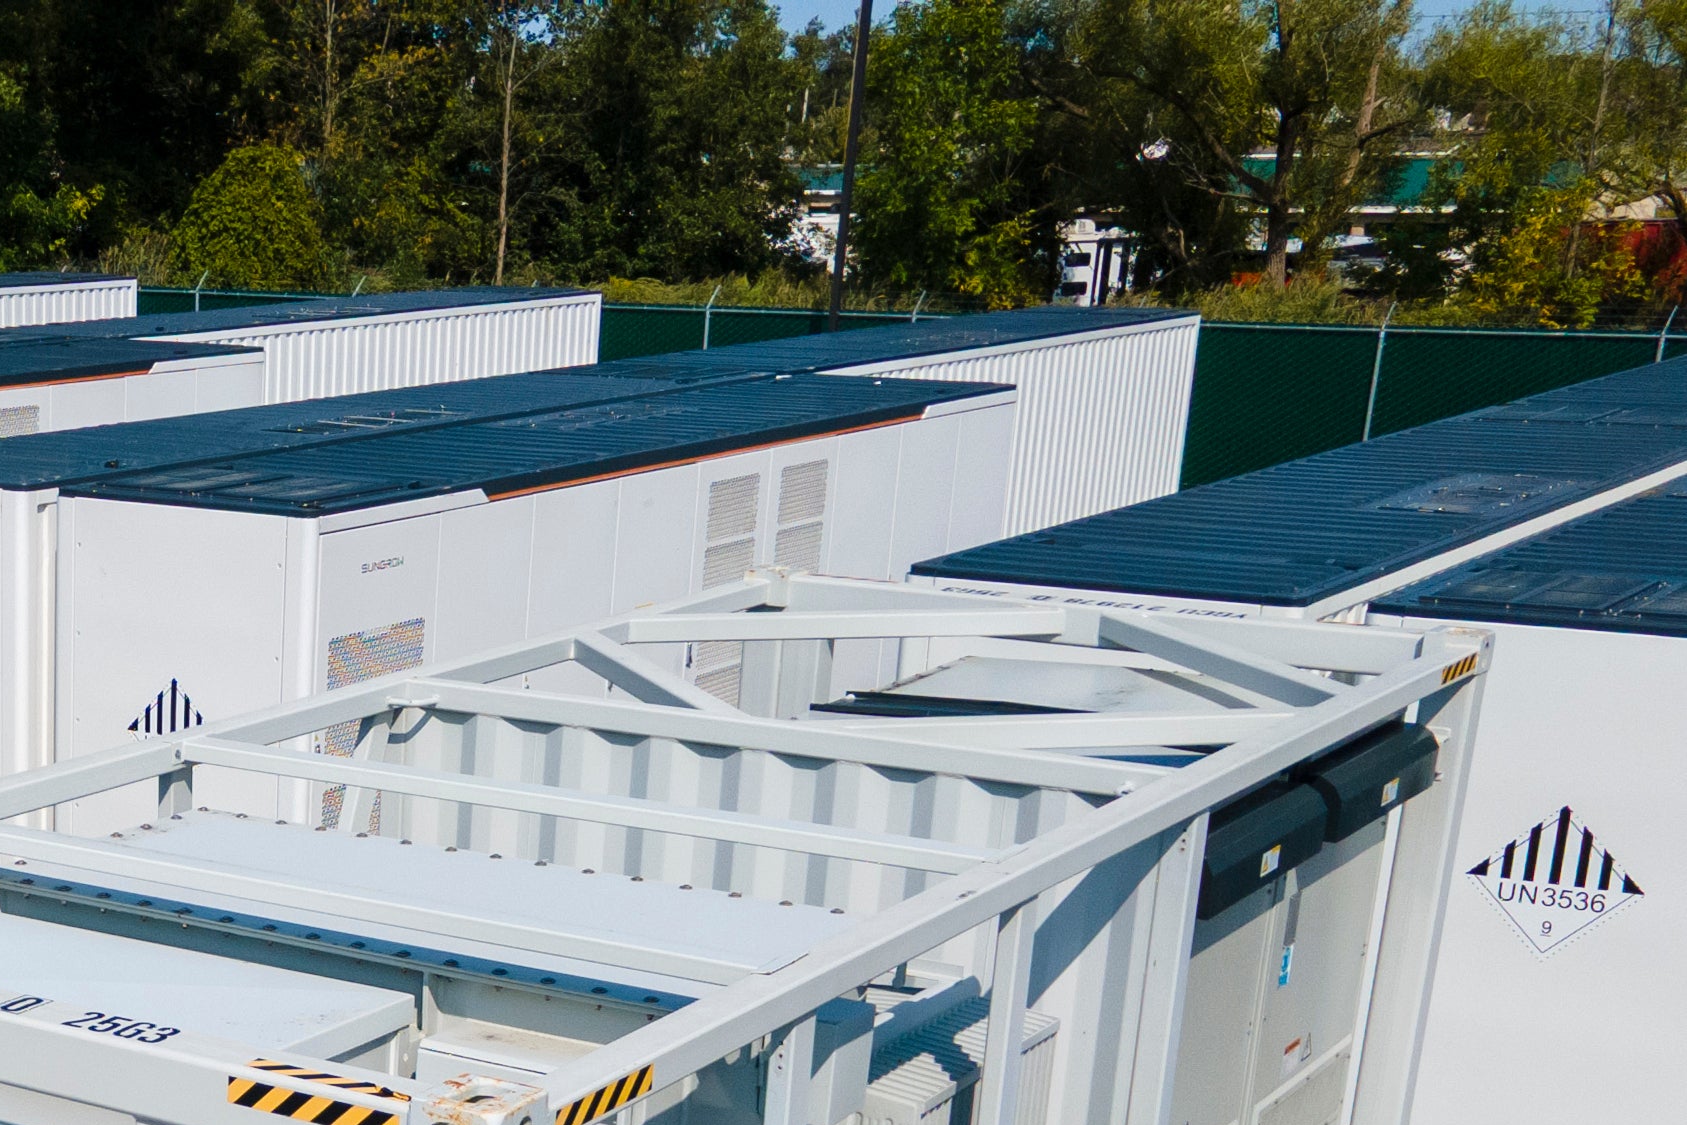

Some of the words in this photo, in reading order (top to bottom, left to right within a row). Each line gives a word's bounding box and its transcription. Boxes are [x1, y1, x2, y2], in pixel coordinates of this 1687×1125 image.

[361, 555, 404, 574] SUNGROW
[1498, 881, 1607, 913] UN3536
[1541, 920, 1552, 934] 9
[0, 997, 44, 1011] 0
[61, 1011, 181, 1044] 25G3
